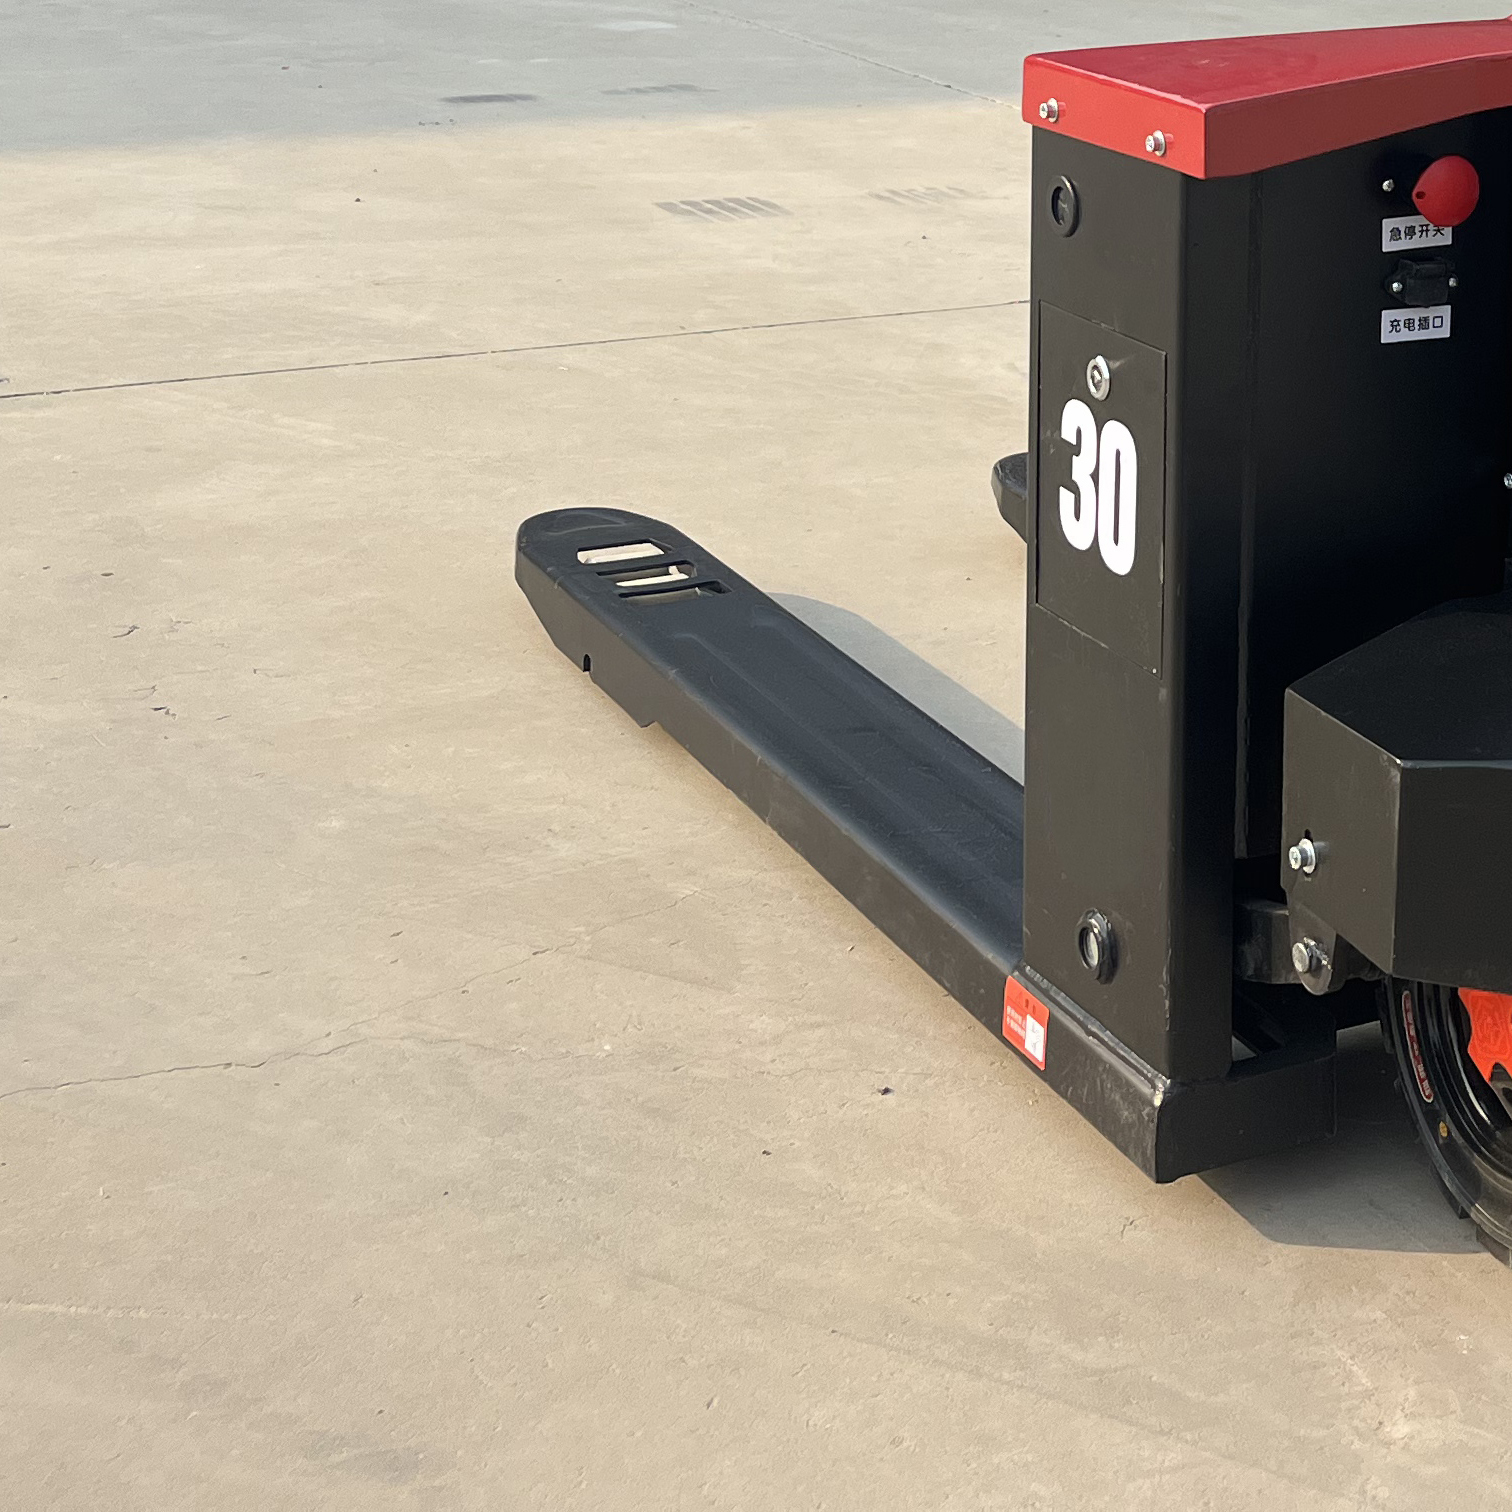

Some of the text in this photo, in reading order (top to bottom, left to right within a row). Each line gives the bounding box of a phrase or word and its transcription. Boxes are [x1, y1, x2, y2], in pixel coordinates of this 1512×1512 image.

[1389, 224, 1445, 242] 急停开关
[1389, 316, 1444, 334] 充电插口
[1059, 398, 1138, 576] 30
